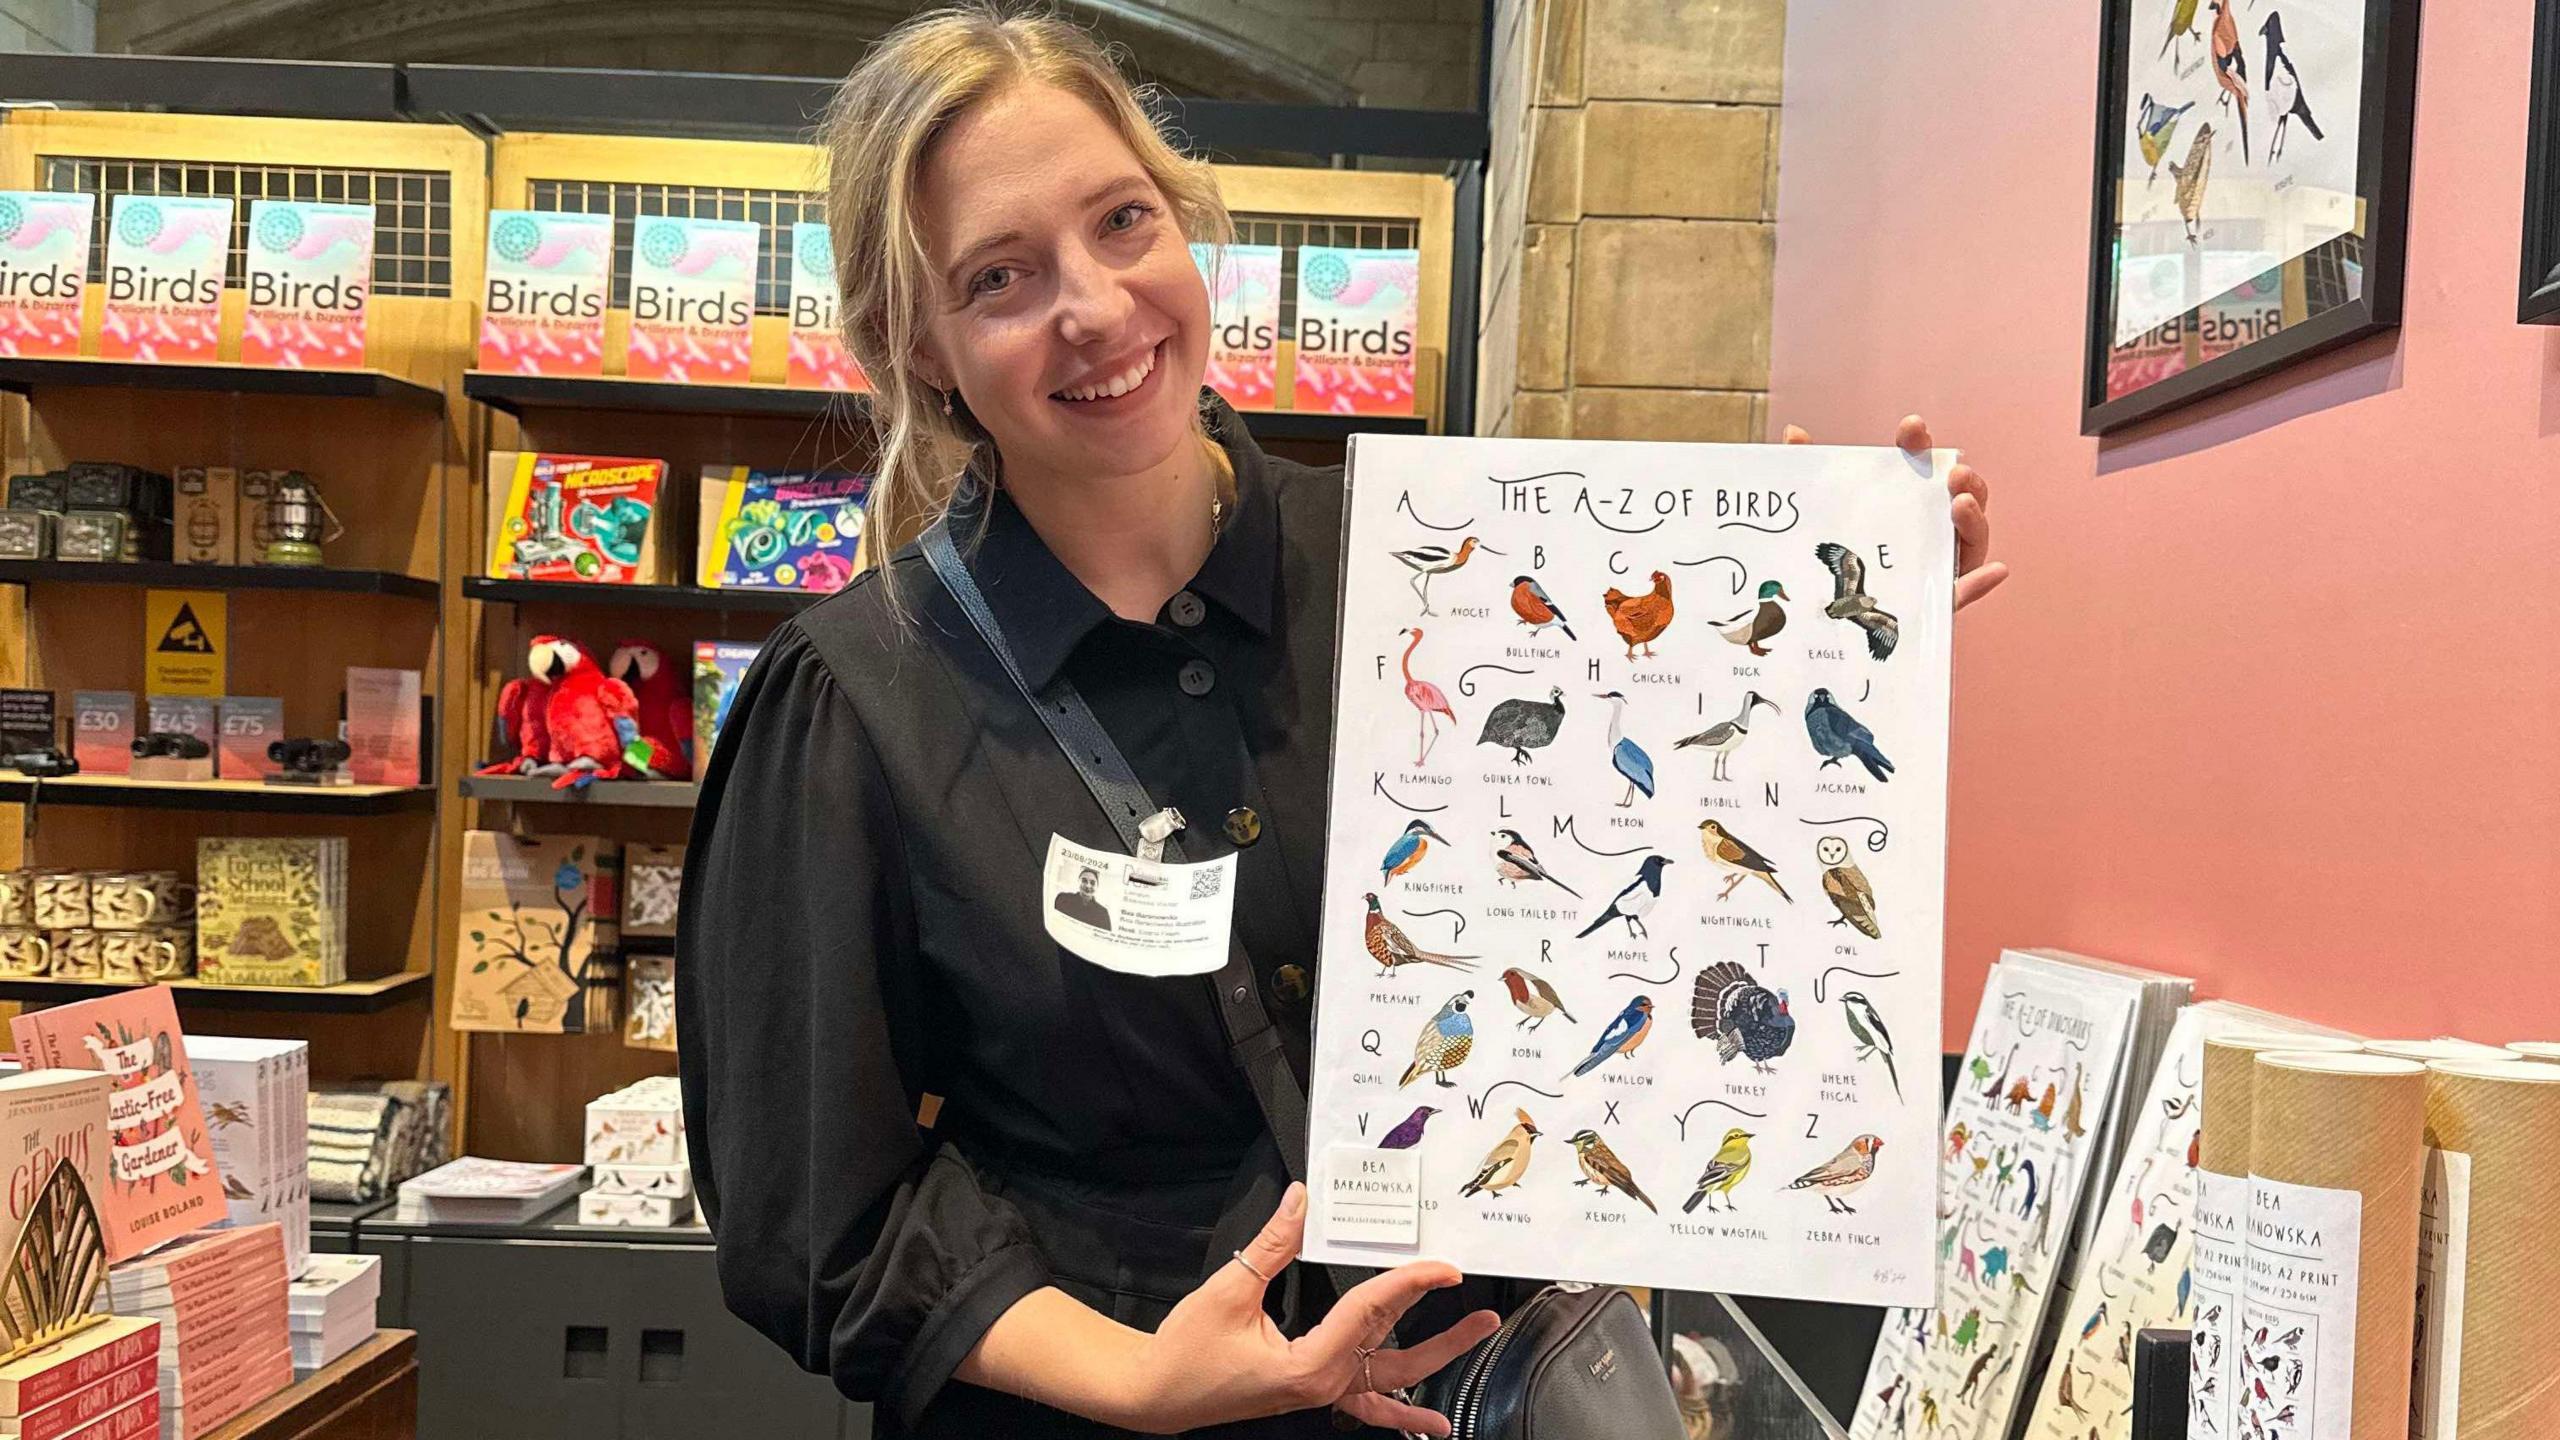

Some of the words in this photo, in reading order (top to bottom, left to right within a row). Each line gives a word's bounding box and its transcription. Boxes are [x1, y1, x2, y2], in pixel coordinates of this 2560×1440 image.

[0, 261, 80, 299] irds
[109, 265, 219, 304] Birds
[250, 271, 365, 310] Birds
[487, 279, 601, 318] Birds
[635, 286, 749, 326] Birds
[1300, 317, 1411, 356] Birds
[1654, 488, 1694, 517] OF
[1716, 488, 1800, 534] BIRDS
[1533, 545, 1546, 570] B
[1608, 551, 1630, 575] C
[1876, 543, 1894, 570] E
[1450, 607, 1492, 619] AVOCET
[1506, 647, 1561, 660] BULLFINCH
[1808, 648, 1846, 660] EAGLE
[1376, 655, 1387, 681] F
[1587, 658, 1601, 682] H
[1632, 672, 1682, 685] CHICKEN
[1733, 666, 1761, 678] DUCK
[1859, 678, 1870, 703] J
[1697, 691, 1703, 716] I
[80, 711, 119, 732] £30
[155, 712, 197, 734] £45
[223, 714, 264, 736] £75
[1399, 773, 1453, 786] FLAMINGO
[1483, 773, 1522, 785] GUINEA
[1526, 775, 1554, 787] FOWL
[1815, 783, 1866, 795] JACKDAW
[1765, 782, 1780, 808] N
[1500, 795, 1512, 818] L
[1610, 817, 1644, 829] HERON
[228, 854, 284, 876] Forest
[228, 871, 287, 892] School
[1404, 881, 1464, 895] KINGFISHER
[1486, 907, 1515, 918] LONG
[1520, 908, 1557, 920] TAILED
[1562, 910, 1579, 921] TIT
[1700, 915, 1774, 929] NIGHTINGALE
[1541, 938, 1553, 964] R
[1607, 950, 1649, 962] MAGPIE
[1756, 943, 1770, 969] T
[1835, 945, 1859, 956] OWL
[1369, 993, 1421, 1006] PHEASANT
[1361, 1028, 1383, 1057] Q
[116, 1050, 138, 1070] The
[1512, 1047, 1542, 1060] ROBIN
[1353, 1072, 1383, 1085] QUAIL
[1601, 1073, 1654, 1087] SWALLOW
[1725, 1083, 1767, 1097] TURKEY
[1820, 1090, 1859, 1104] FISCAL
[109, 1086, 176, 1121] lastic-Free
[1604, 1100, 1621, 1126] X
[1357, 1111, 1369, 1137] V
[1805, 1113, 1819, 1139] Z
[22, 1127, 42, 1155] THE
[121, 1140, 179, 1173] Gardener
[1362, 1160, 1387, 1174] BEA
[1333, 1178, 1414, 1194] BARANOWSKA
[2256, 1189, 2281, 1211] BEA
[130, 1210, 161, 1234] LOUISE
[163, 1195, 205, 1222] BOLAND
[1481, 1211, 1532, 1225] WAXWING
[1585, 1210, 1627, 1224] XENOPS
[1670, 1223, 1715, 1238] YELLOW
[1721, 1226, 1769, 1241] WAGTAIL
[1806, 1230, 1842, 1244] ZEBRA
[1848, 1233, 1881, 1246] FINCH
[2218, 1253, 2242, 1268] PRIN
[2277, 1266, 2294, 1281] A2
[2300, 1270, 2339, 1287] PRINT
